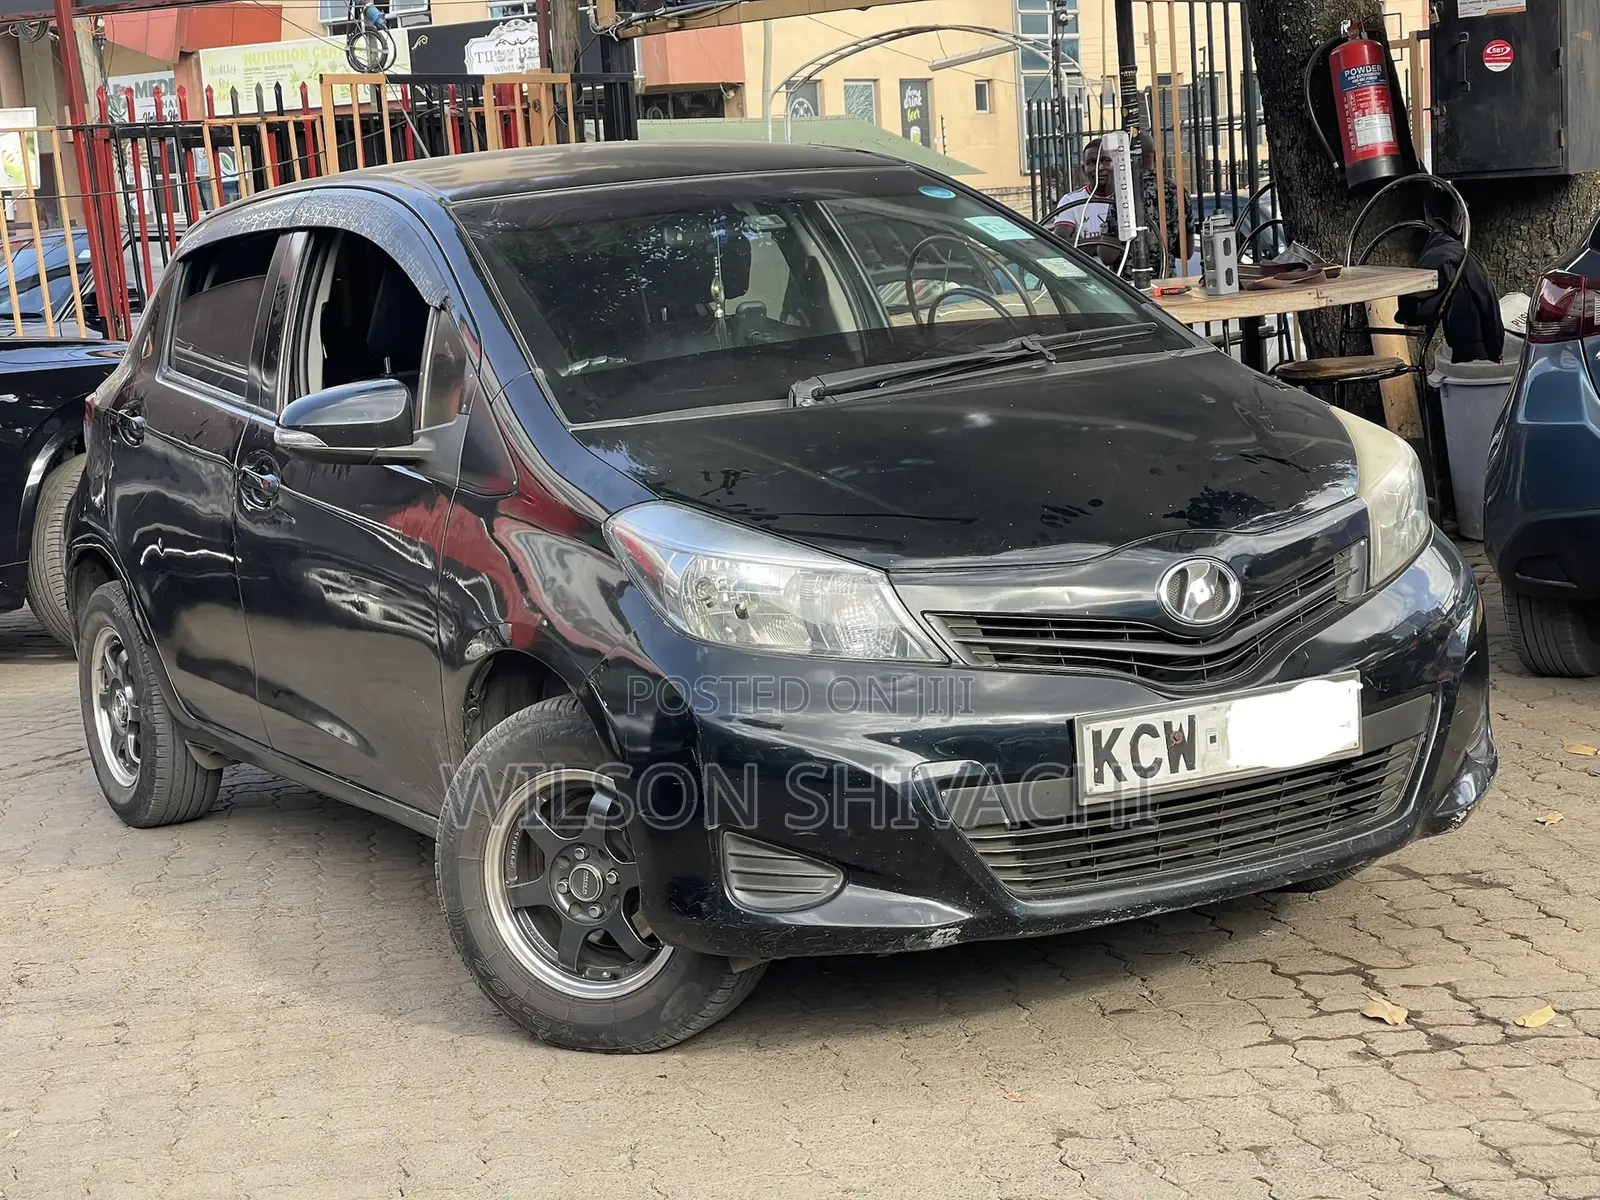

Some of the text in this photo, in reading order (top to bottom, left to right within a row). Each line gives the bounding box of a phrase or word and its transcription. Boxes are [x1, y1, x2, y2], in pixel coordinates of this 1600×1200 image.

[243, 47, 308, 66] NUTRITION
[474, 48, 515, 63] TIPSY
[1344, 64, 1382, 78] POWDER
[1510, 311, 1528, 328] PUS
[1092, 714, 1197, 785] KCW
